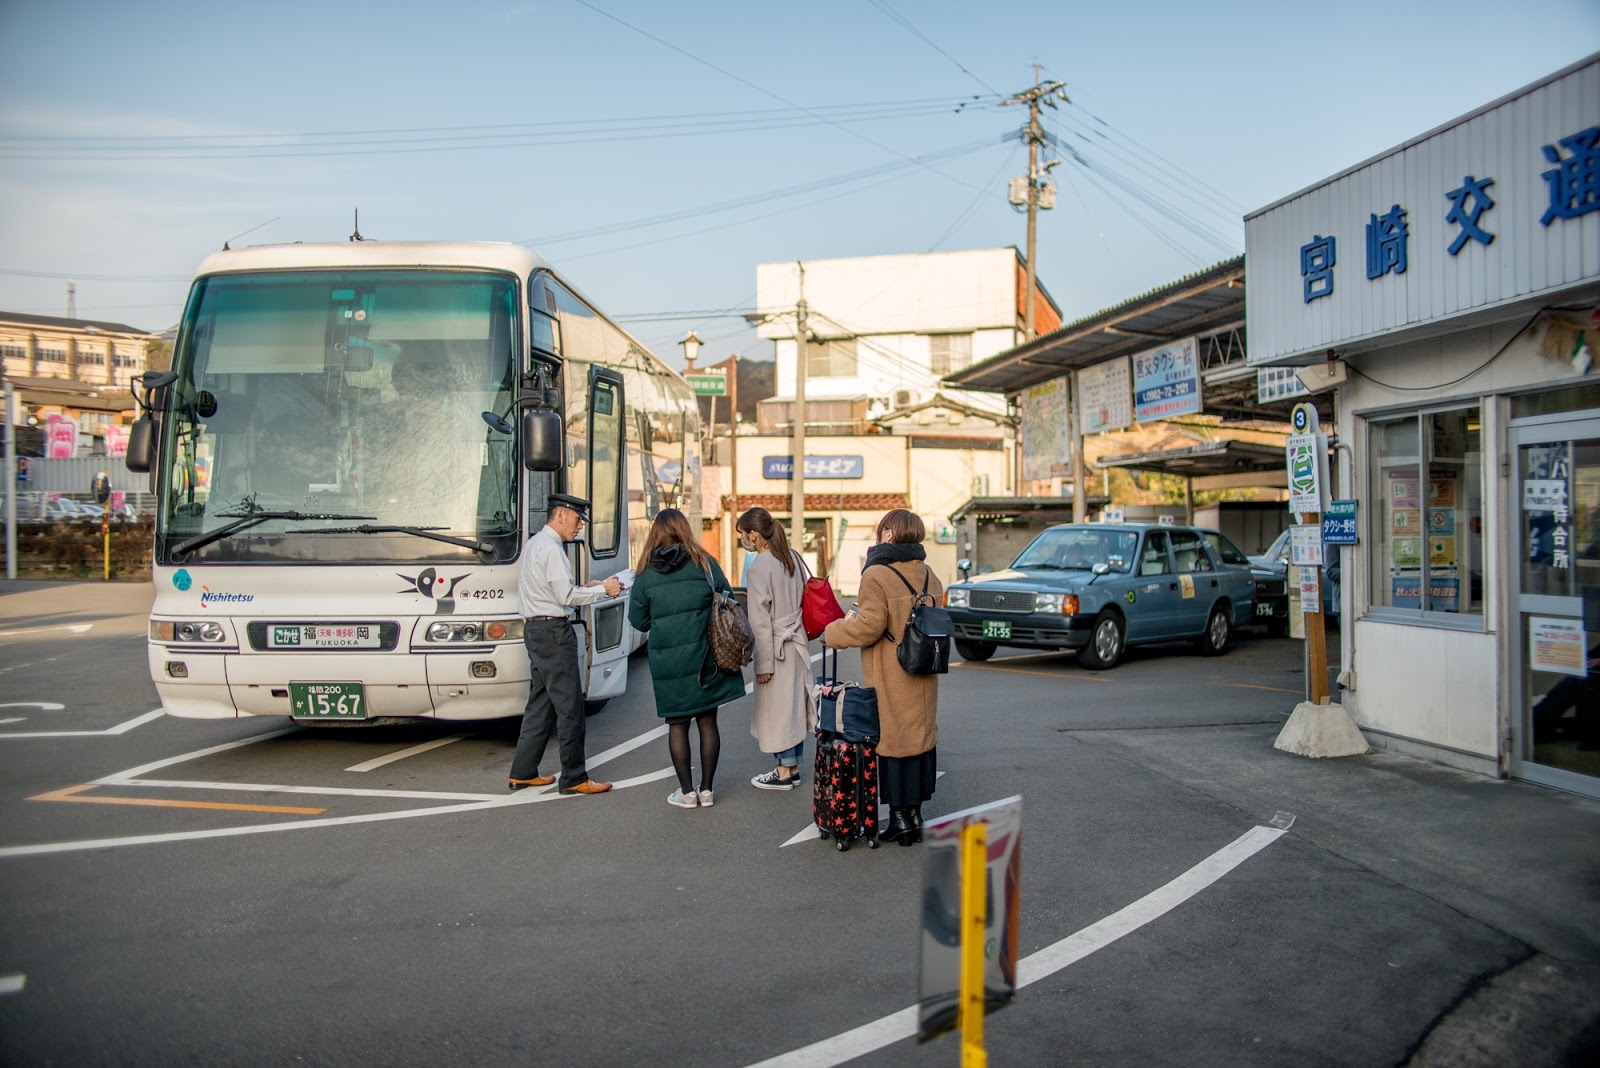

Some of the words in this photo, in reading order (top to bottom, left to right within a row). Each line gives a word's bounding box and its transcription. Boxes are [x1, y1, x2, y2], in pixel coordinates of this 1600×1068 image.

[1300, 127, 1600, 304] 宮崎交通
[1296, 412, 1305, 426] 3
[1324, 519, 1355, 533] タクシー受付
[201, 592, 254, 602] Nishitetsu
[473, 589, 504, 599] 4202
[988, 627, 1010, 638] 21-55
[307, 694, 360, 715] 15-67
